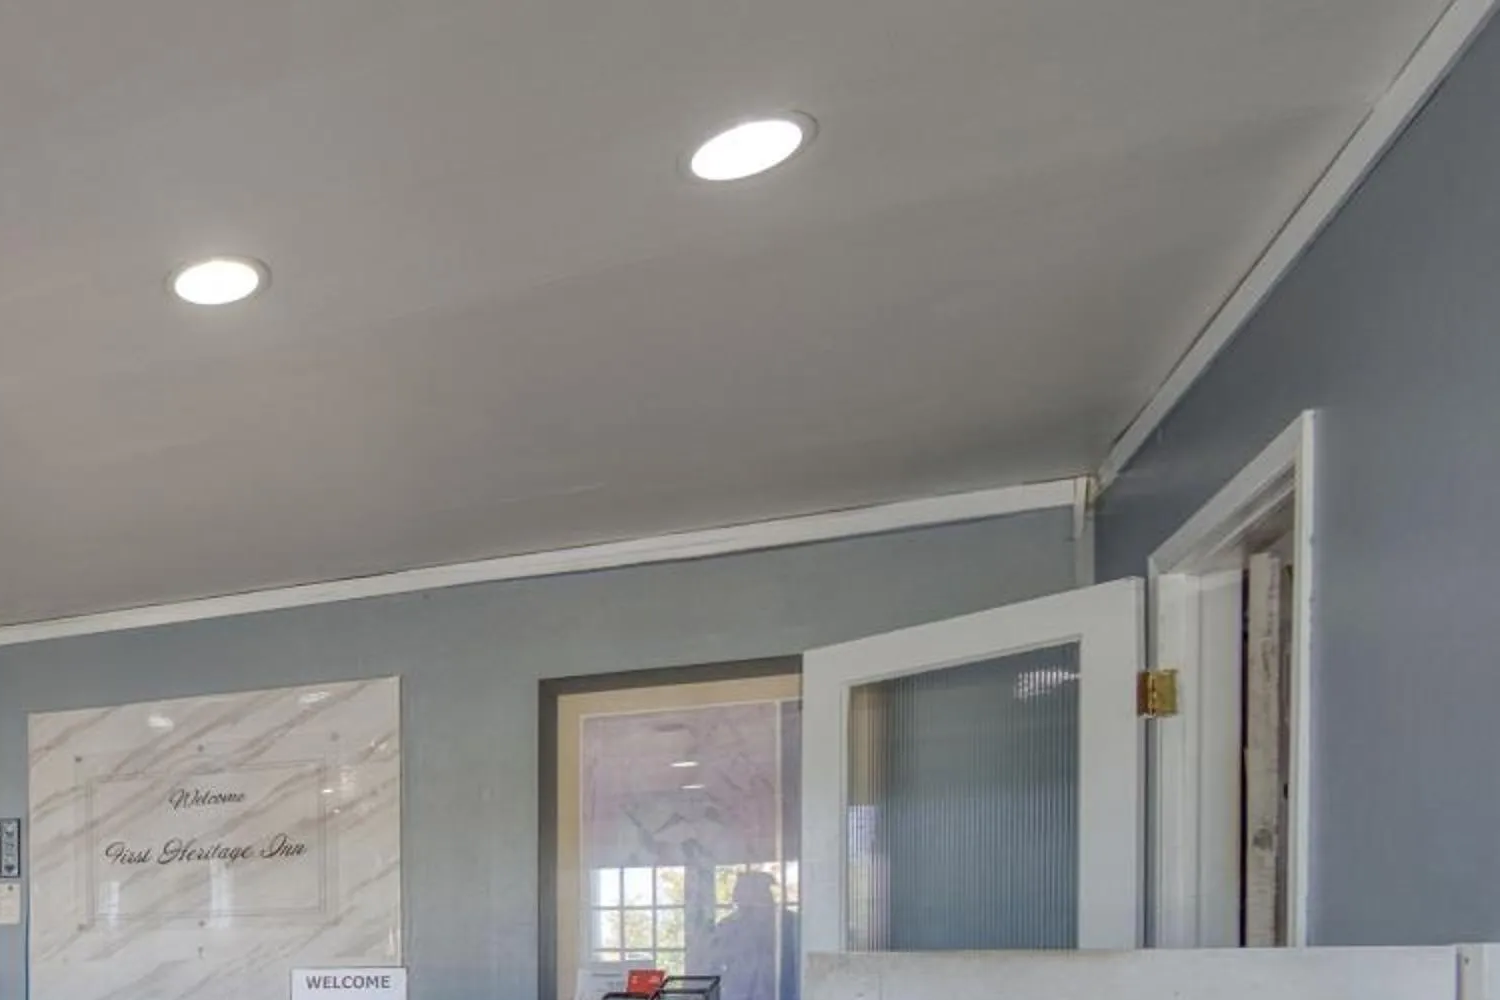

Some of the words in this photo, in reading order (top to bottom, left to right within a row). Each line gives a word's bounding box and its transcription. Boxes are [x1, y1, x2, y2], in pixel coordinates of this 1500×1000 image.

[168, 788, 245, 809] Welcome
[105, 841, 151, 864] First
[157, 837, 254, 864] Heritage
[260, 832, 308, 858] Inn
[305, 975, 391, 989] WELCOME
